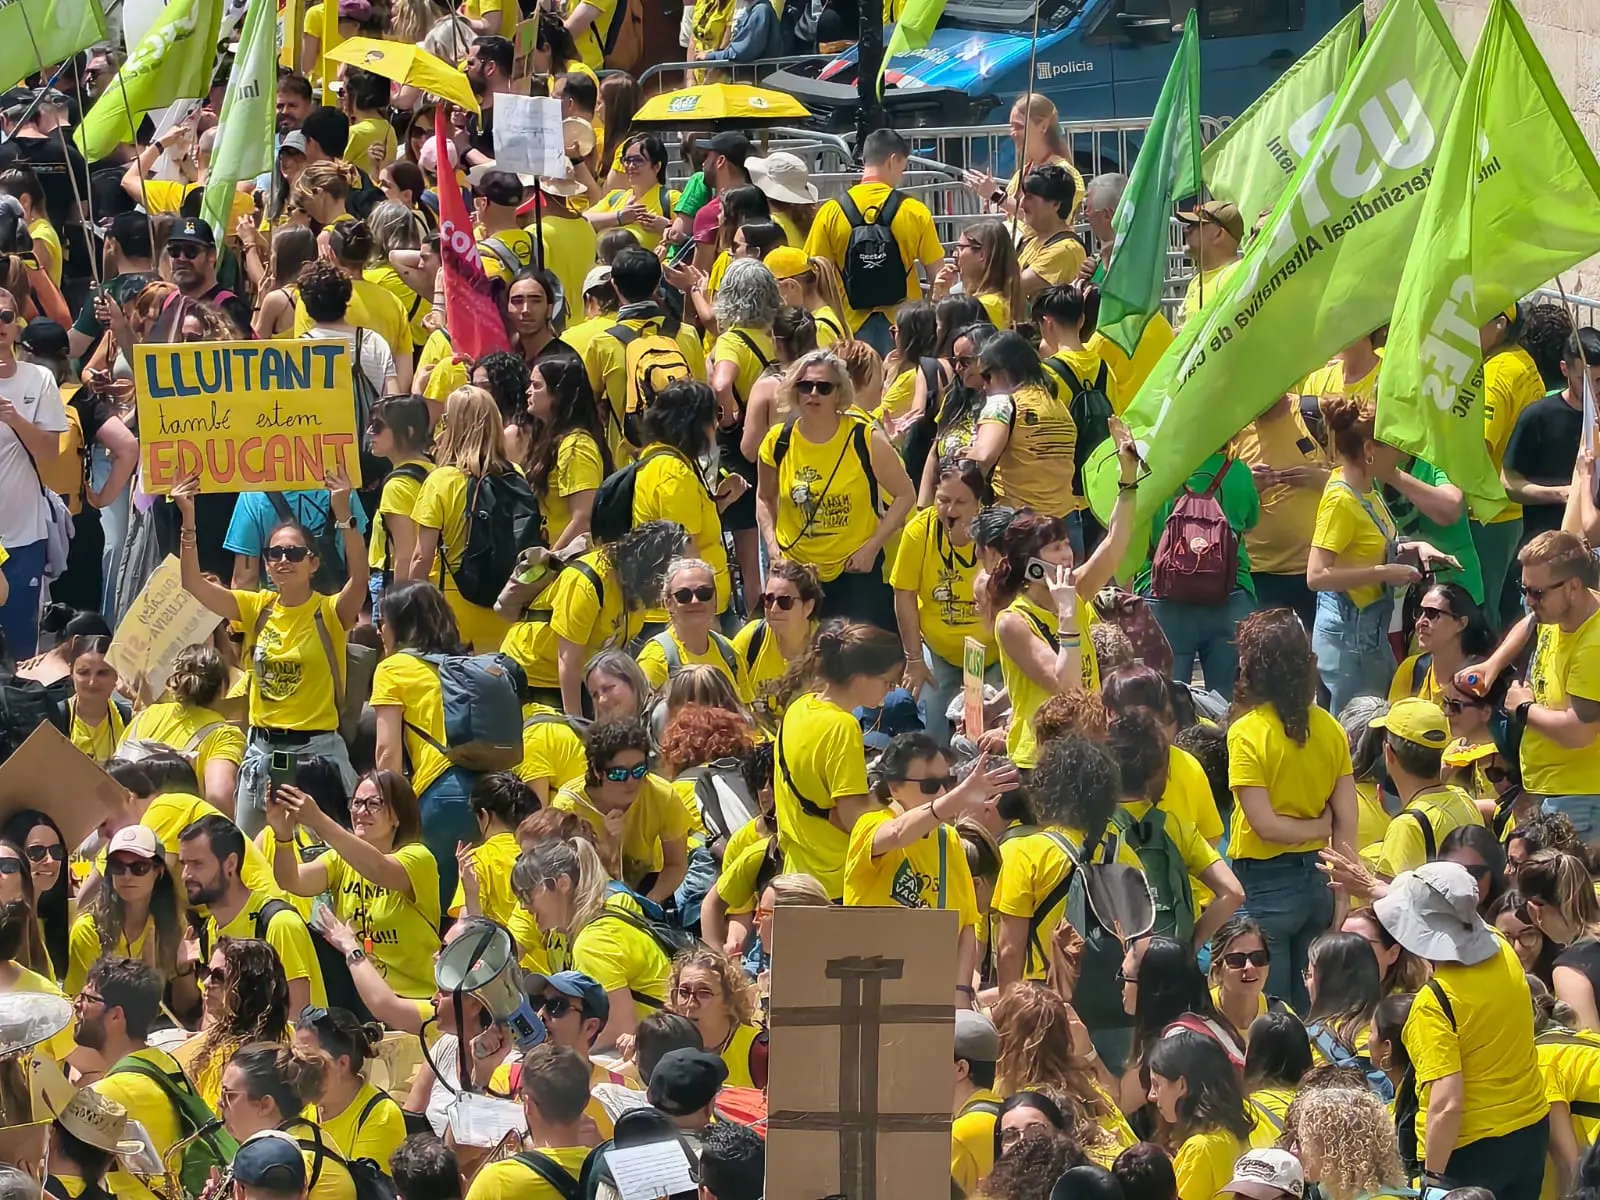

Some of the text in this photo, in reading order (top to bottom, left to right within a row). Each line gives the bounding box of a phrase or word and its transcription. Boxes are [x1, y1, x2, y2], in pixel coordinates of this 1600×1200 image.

[1052, 60, 1094, 76] policia
[145, 345, 345, 399] LLUITANT
[159, 399, 323, 435] també estem
[149, 433, 354, 486] EDUCANT
